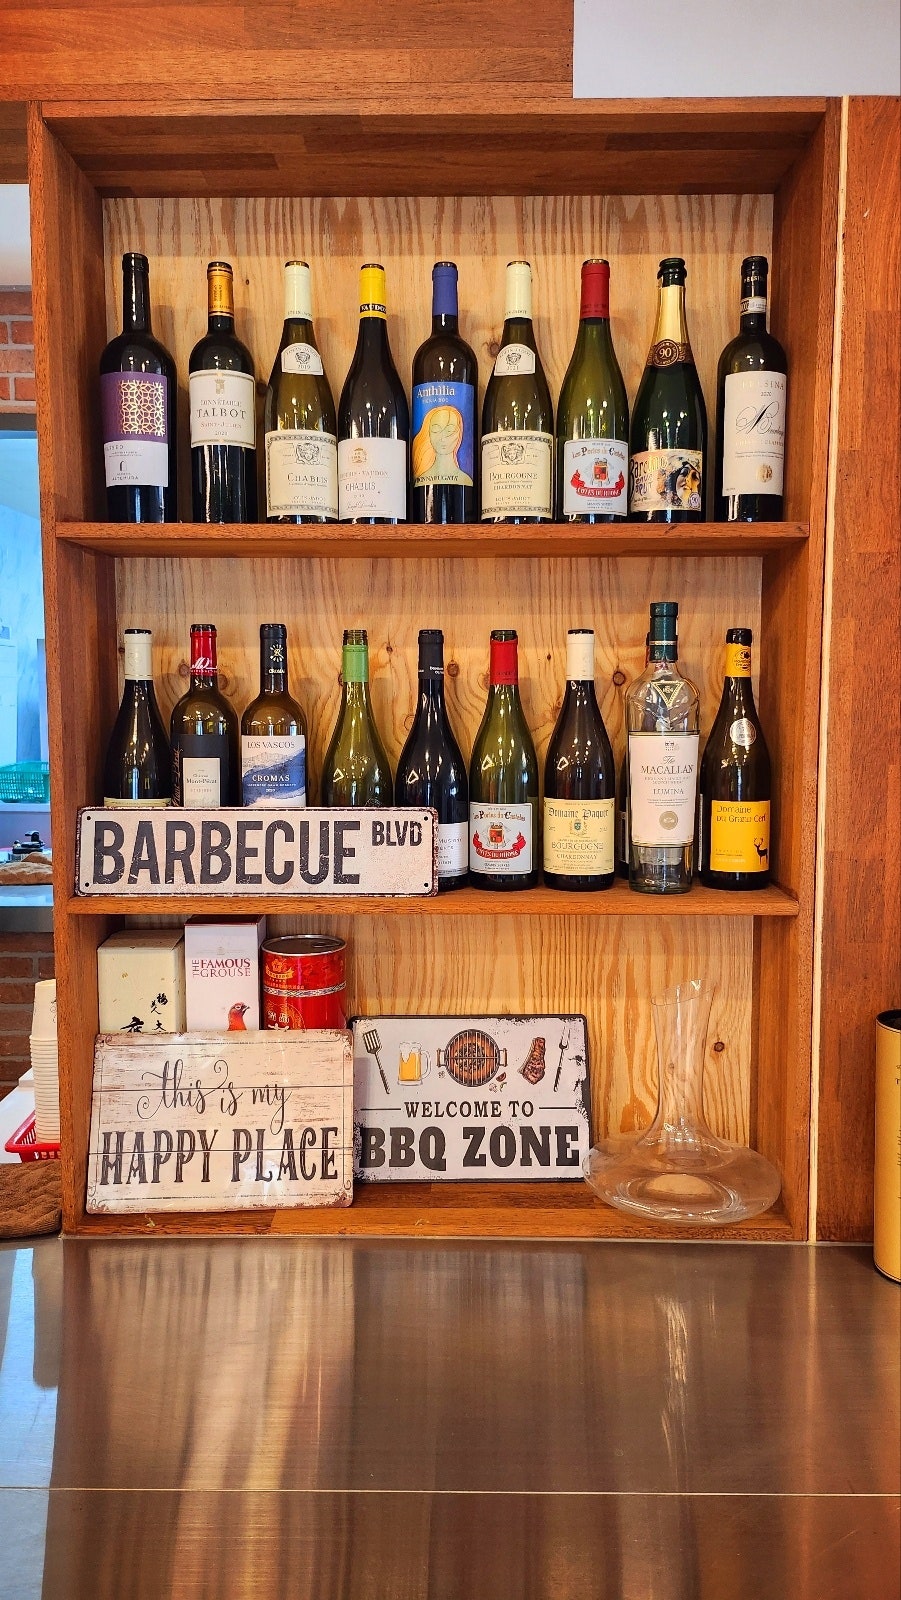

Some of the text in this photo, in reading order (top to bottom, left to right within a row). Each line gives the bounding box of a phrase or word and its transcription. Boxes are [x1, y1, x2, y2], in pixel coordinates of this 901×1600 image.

[660, 347, 671, 358] 90
[417, 385, 455, 398] Anthilia
[196, 407, 246, 419] TALBOT
[489, 472, 538, 481] BOURGOGNE
[345, 481, 377, 492] CHABLIS
[247, 741, 295, 749] LOS VASCOS
[641, 764, 694, 775] MACALLAN
[252, 774, 290, 782] CROMAS
[551, 841, 604, 851] BOURGOGNE
[92, 820, 422, 885] BARBECUE BLVD
[192, 957, 251, 978] THE FAMOUS
[200, 968, 251, 978] GROUSE
[137, 1058, 293, 1136] this is my
[403, 1101, 535, 1118] WELCOME TO
[358, 1125, 580, 1171] BBQ ZONE
[100, 1127, 339, 1186] HAPPY PLACE
